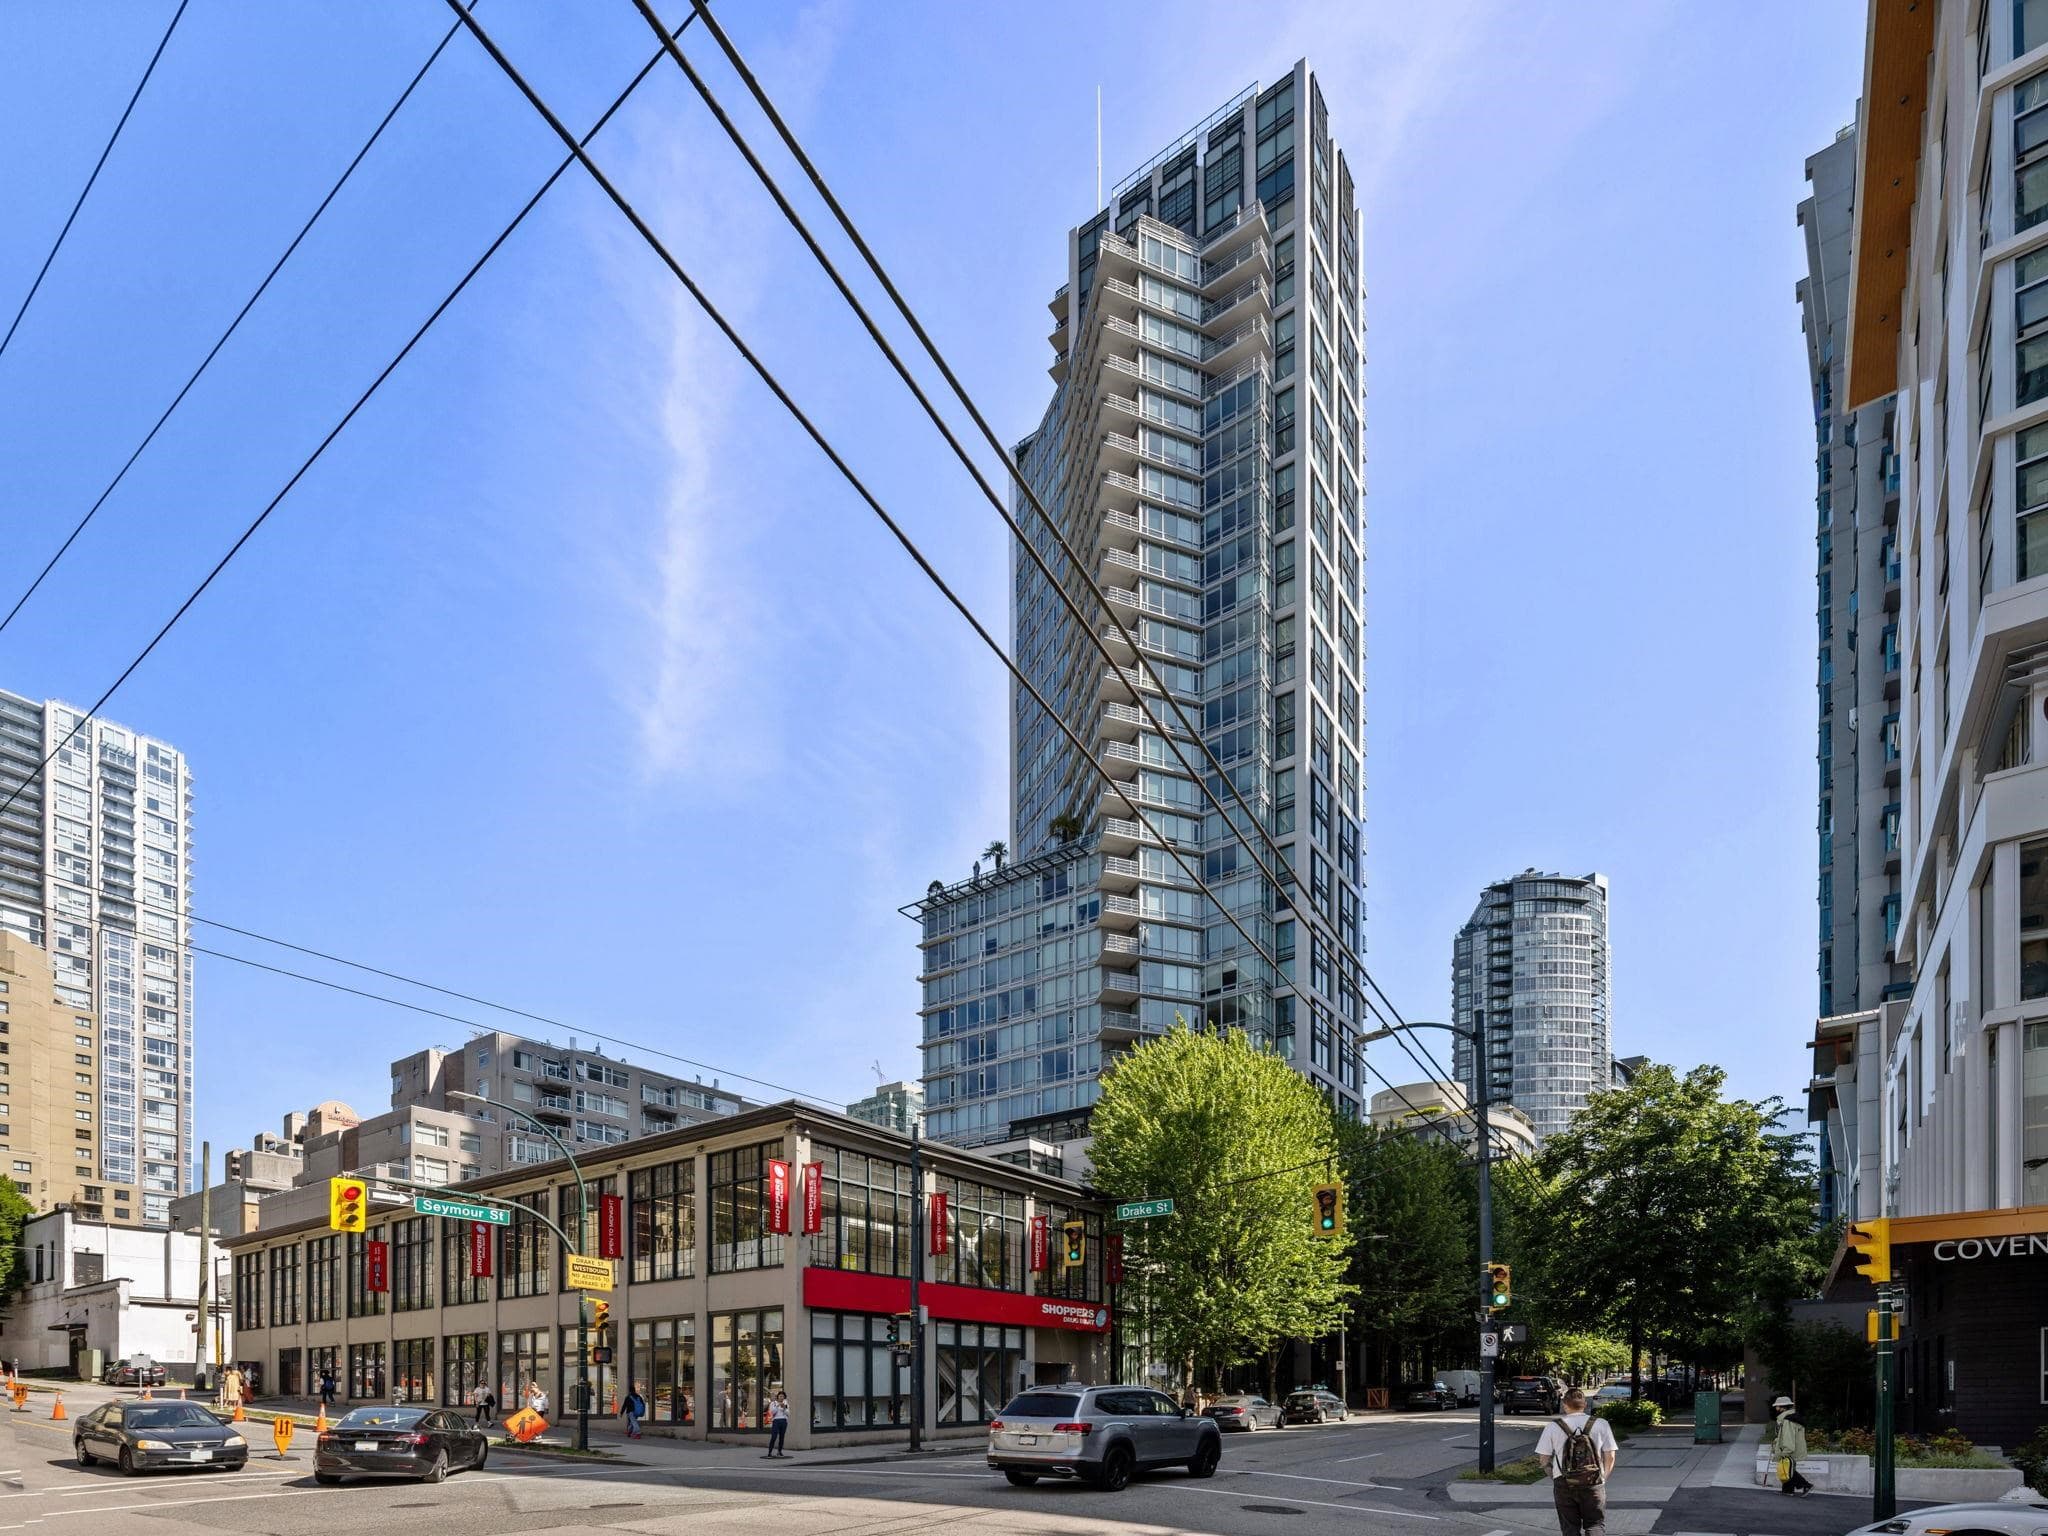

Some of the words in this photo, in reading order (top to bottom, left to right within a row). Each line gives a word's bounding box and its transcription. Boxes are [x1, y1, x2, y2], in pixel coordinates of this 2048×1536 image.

[422, 1200, 484, 1217] Seymour
[490, 1210, 504, 1221] St
[1122, 1206, 1152, 1217] Drake
[1156, 1202, 1168, 1213] St
[1934, 1235, 2048, 1261] COVEN
[575, 1258, 595, 1266] DRAKE
[573, 1265, 609, 1275] WESTBOUND
[1042, 1303, 1095, 1318] SHOPPERS
